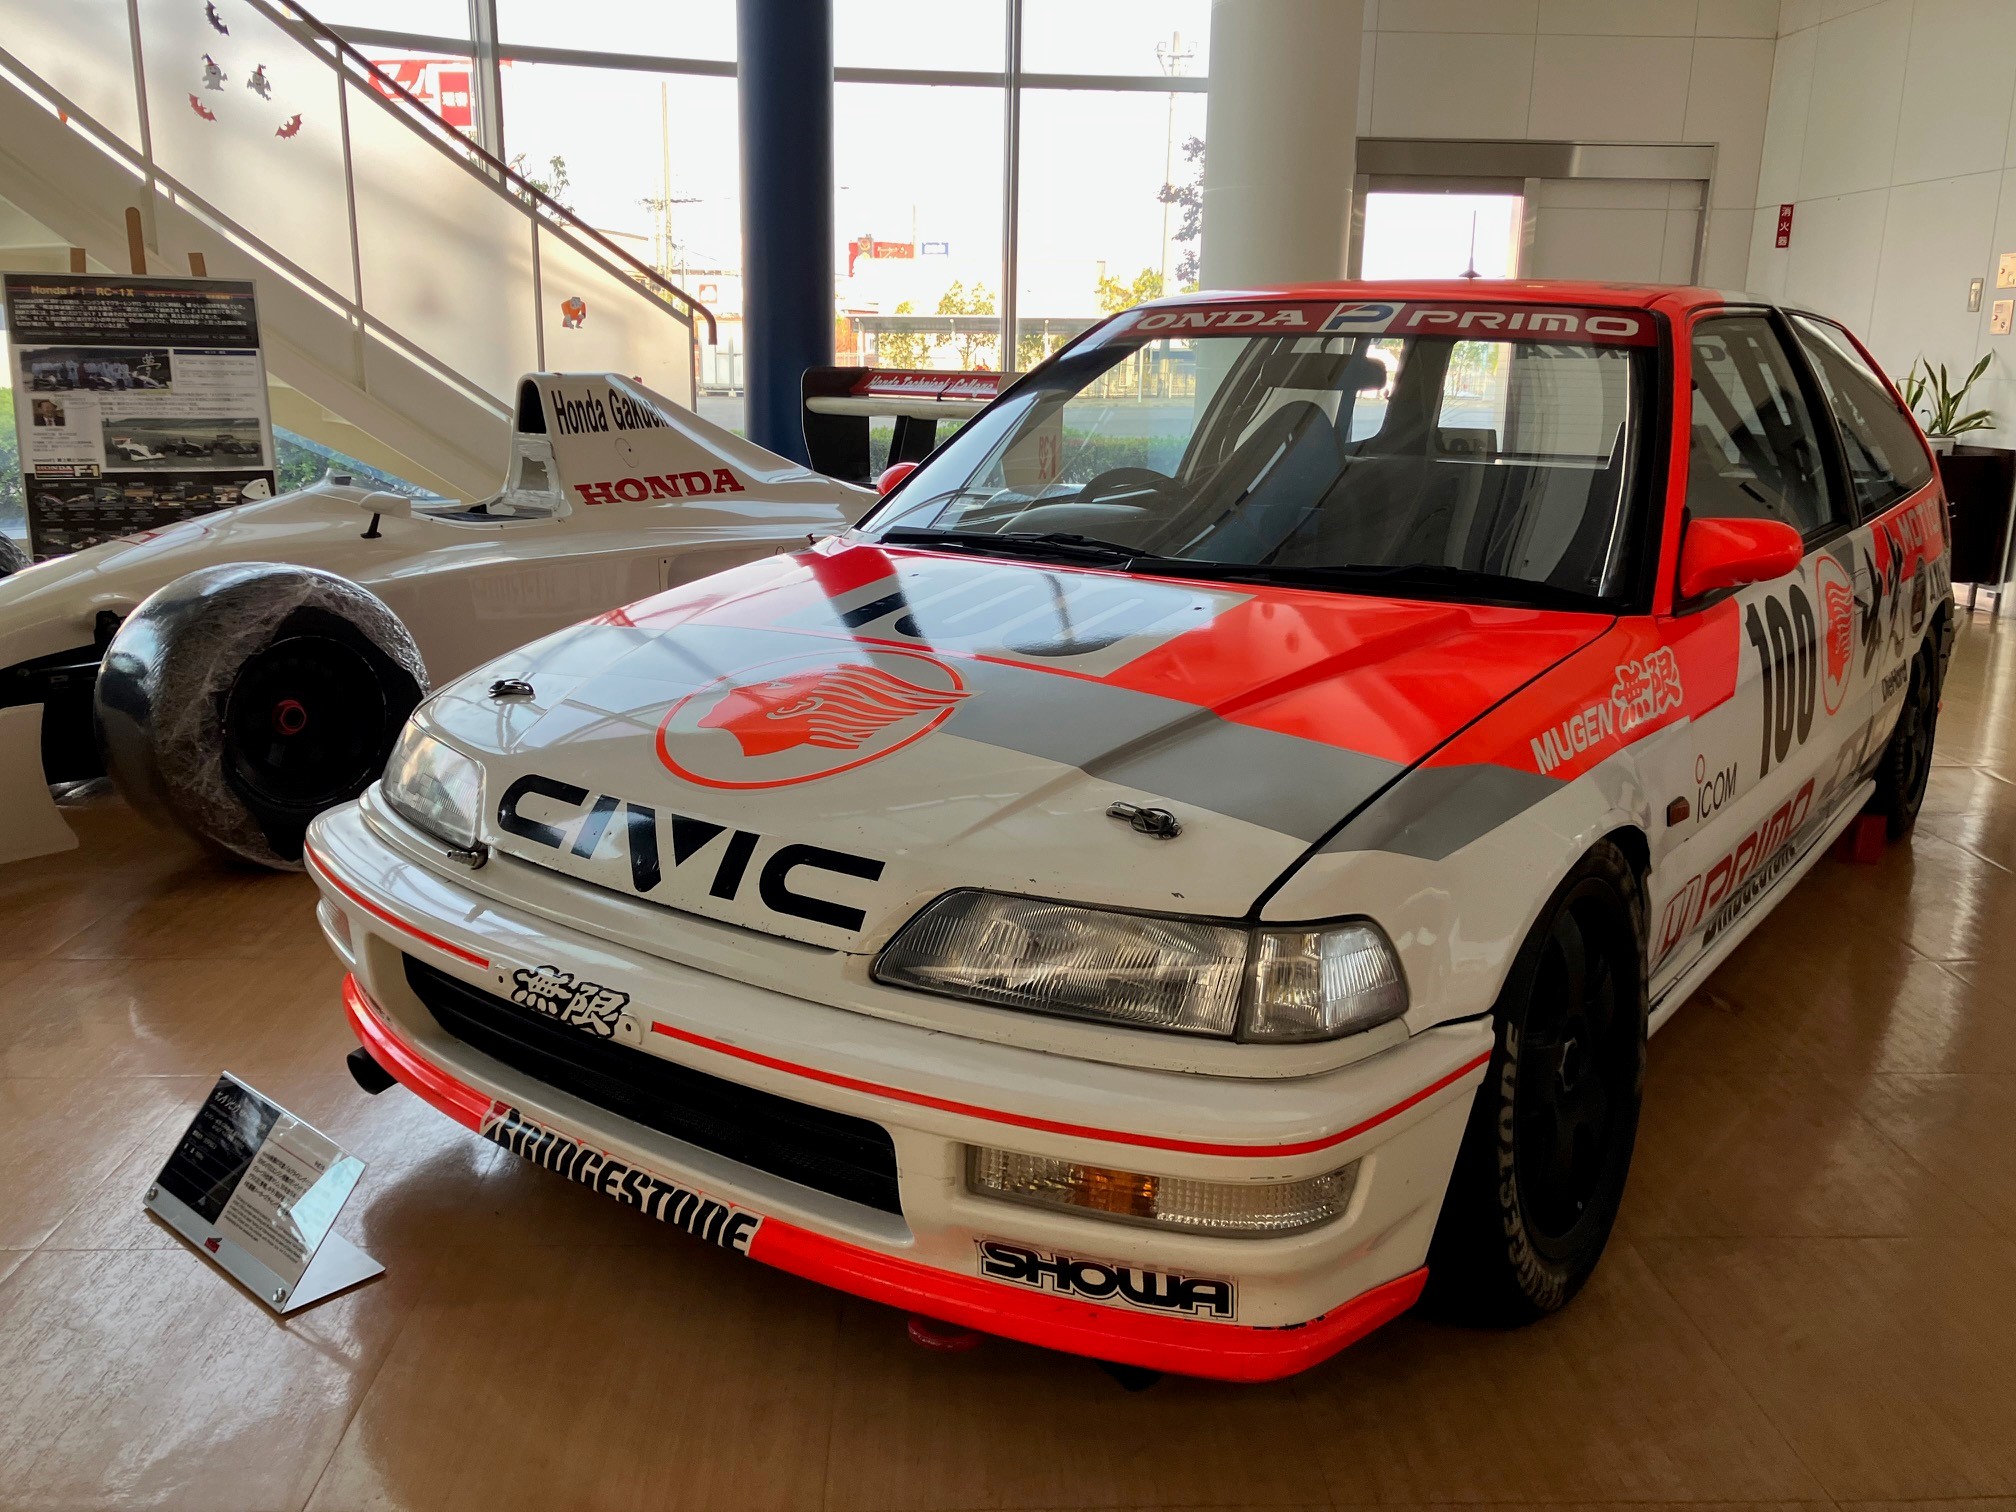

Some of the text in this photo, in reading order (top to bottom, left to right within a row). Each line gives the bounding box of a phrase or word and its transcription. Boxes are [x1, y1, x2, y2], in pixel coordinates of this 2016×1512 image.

[1778, 207, 1791, 246] 消火器
[31, 285, 67, 295] Honda
[1130, 308, 1309, 331] ONDA
[1407, 309, 1639, 336] PRIMO
[551, 388, 669, 435] Honda Gakuen
[865, 375, 994, 397] Honda Technical College
[574, 468, 745, 505] HONDA
[1745, 584, 1816, 779] 100
[1530, 700, 1614, 775] MUGEN
[498, 774, 885, 932] CIVIC
[511, 965, 630, 1039] 無限
[482, 1106, 759, 1256] BRIDGESTONE
[980, 1239, 1233, 1317] SHOWA
